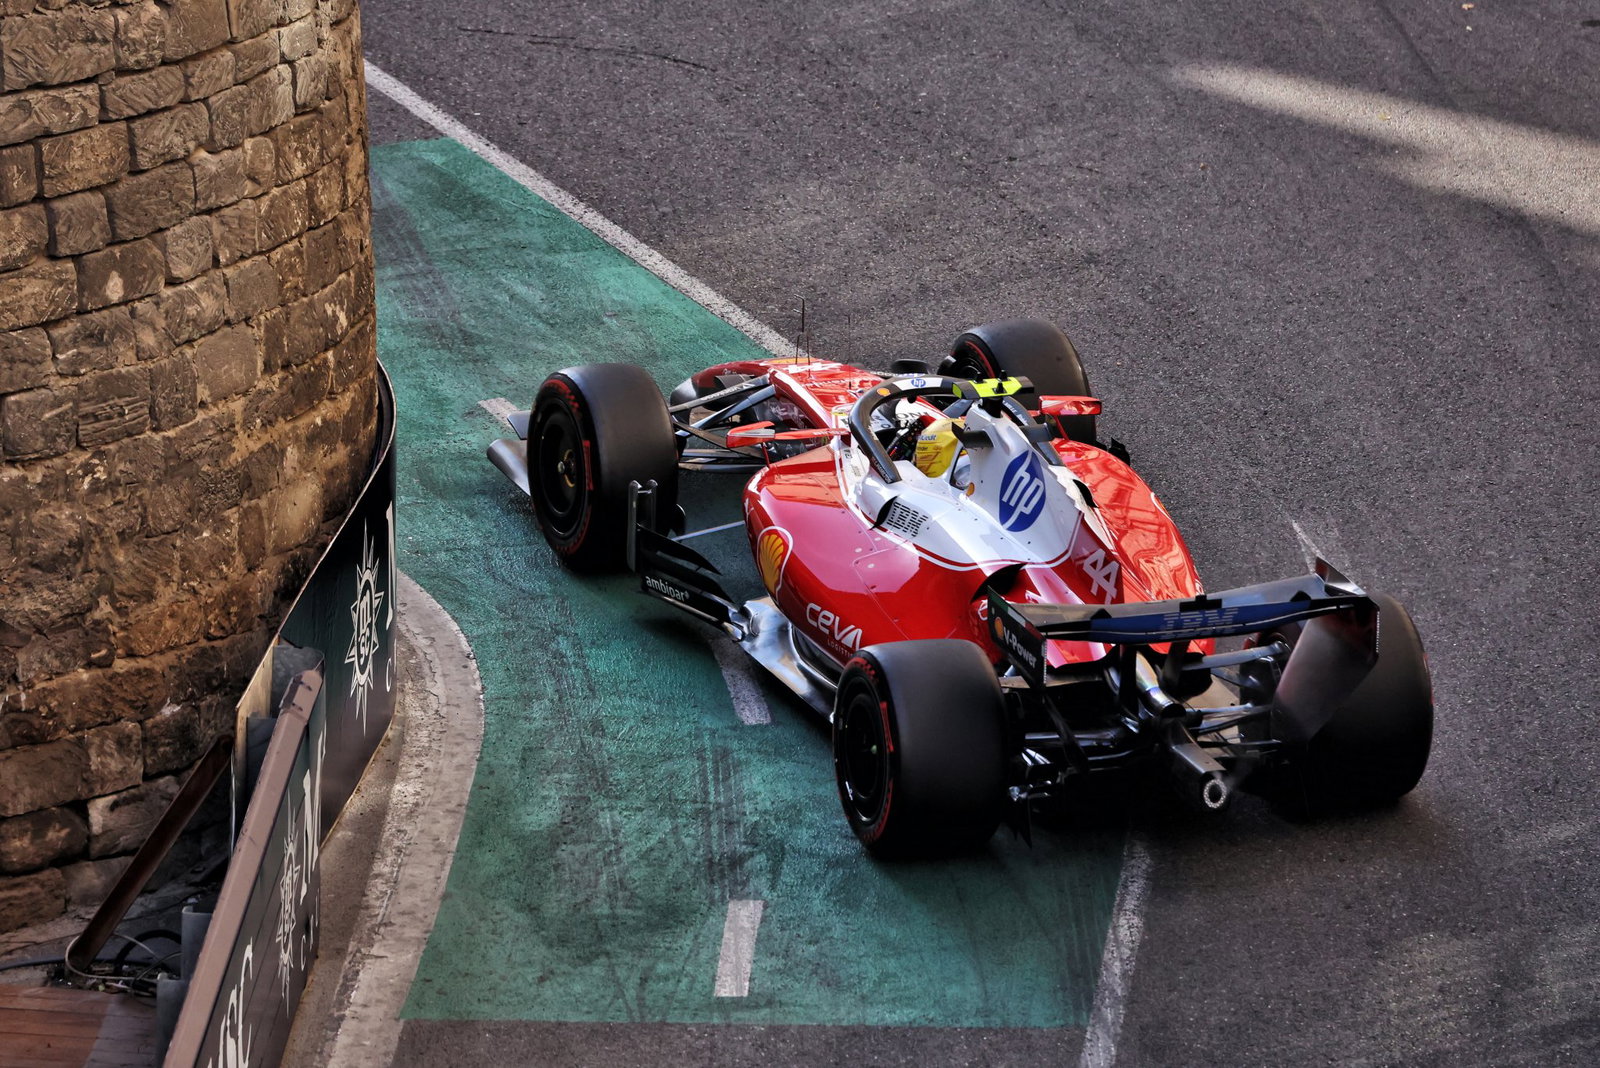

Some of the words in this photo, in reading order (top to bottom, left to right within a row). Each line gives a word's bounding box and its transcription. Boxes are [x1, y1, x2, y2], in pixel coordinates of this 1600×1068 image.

[912, 378, 925, 388] hp
[1001, 450, 1046, 530] hp
[1082, 548, 1120, 605] 44
[1162, 609, 1248, 645] IBM
[827, 639, 853, 658] LOGISTI
[1003, 626, 1037, 669] V-Power
